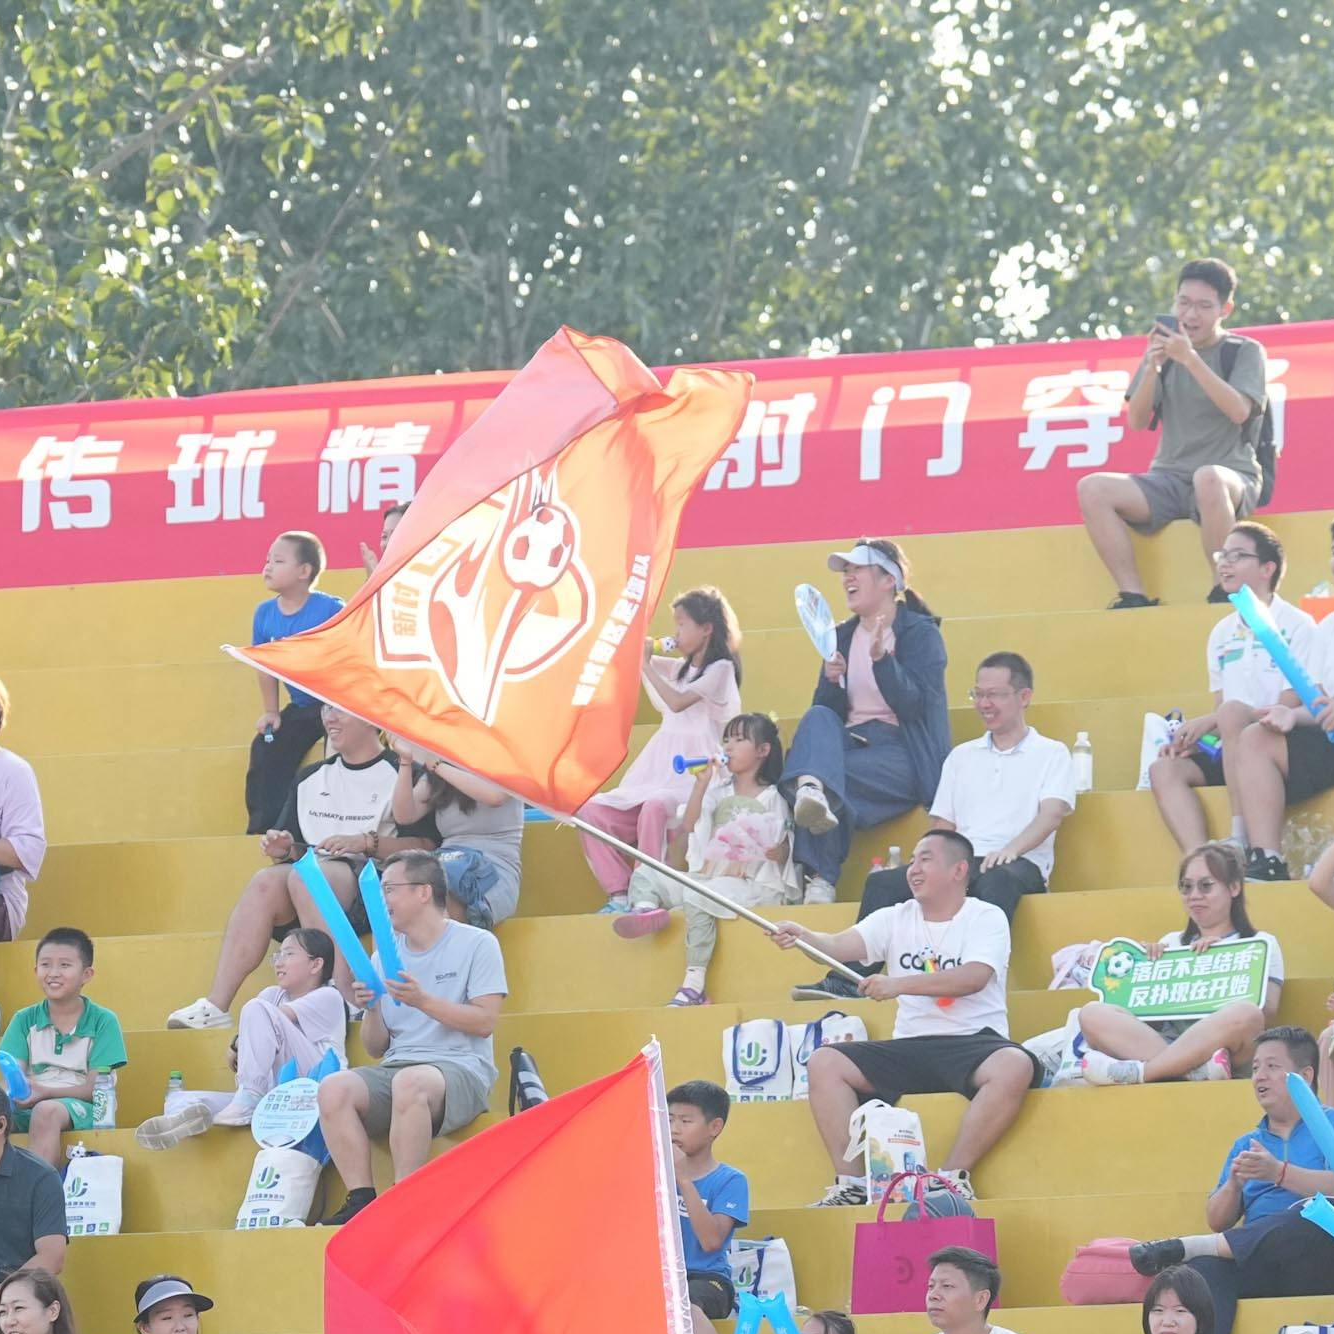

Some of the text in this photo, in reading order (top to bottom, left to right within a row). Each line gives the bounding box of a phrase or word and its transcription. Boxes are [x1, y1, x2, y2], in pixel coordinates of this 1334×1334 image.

[17, 421, 433, 532] 传球精
[309, 810, 344, 821] ULTIMATE
[1129, 947, 1251, 983] 落后不是结束
[1127, 975, 1252, 1008] 反扑现在开始
